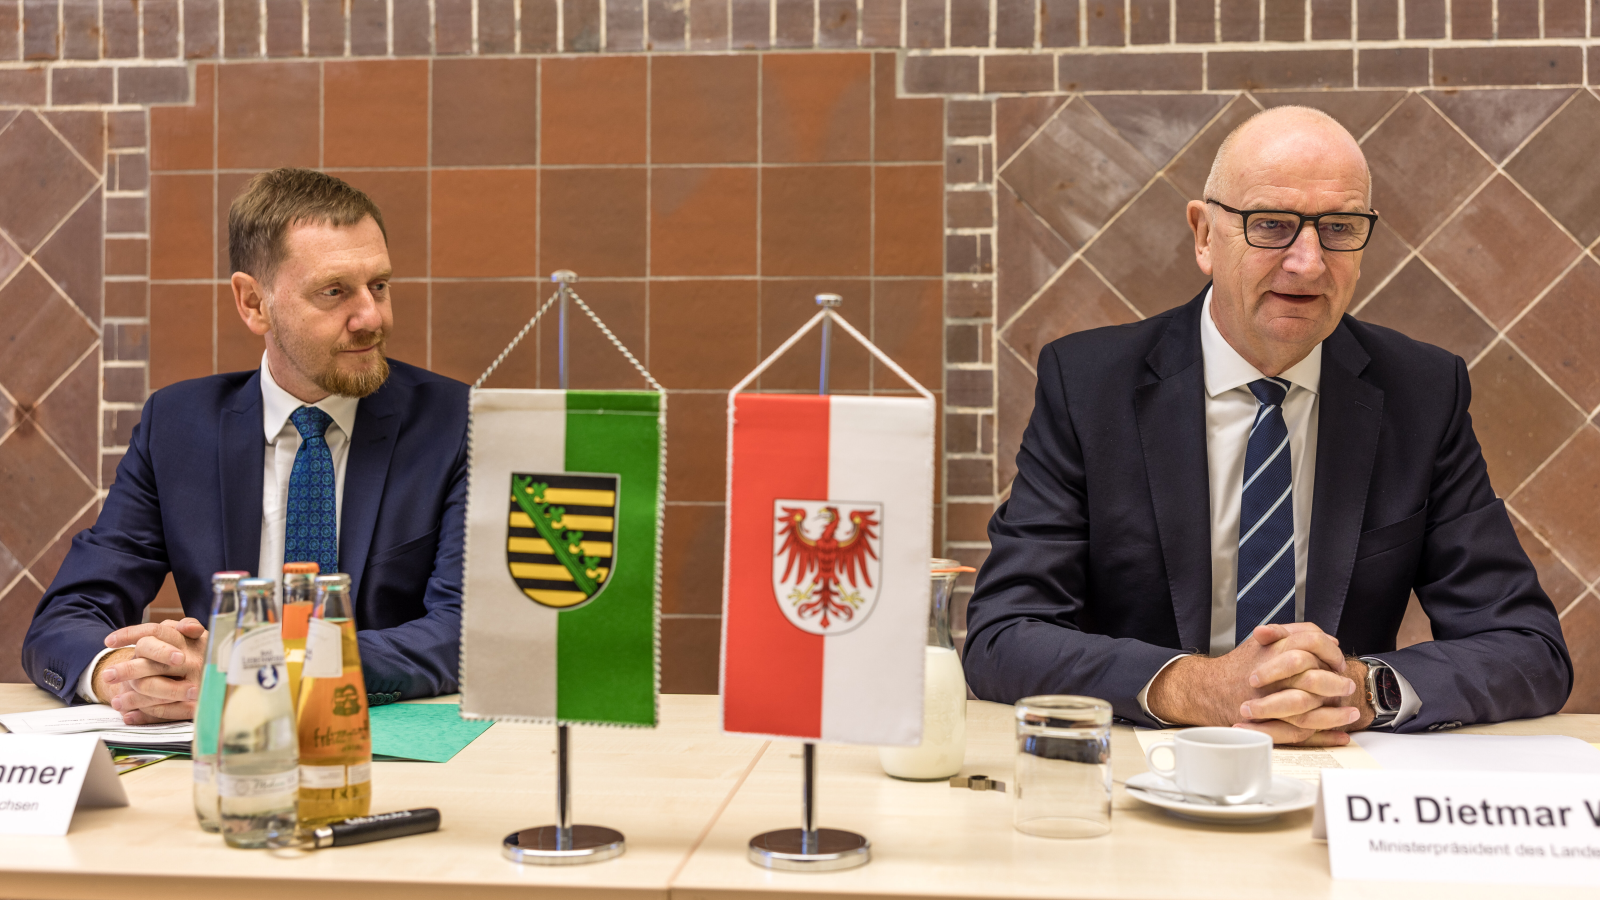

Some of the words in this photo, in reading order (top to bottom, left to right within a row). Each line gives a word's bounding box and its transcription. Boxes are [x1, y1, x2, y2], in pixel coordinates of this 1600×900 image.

[0, 764, 74, 785] mer
[1346, 794, 1400, 824] Dr.
[1414, 796, 1572, 828] Dietmar
[1368, 838, 1511, 857] Ministerpräsident
[1515, 843, 1546, 858] des
